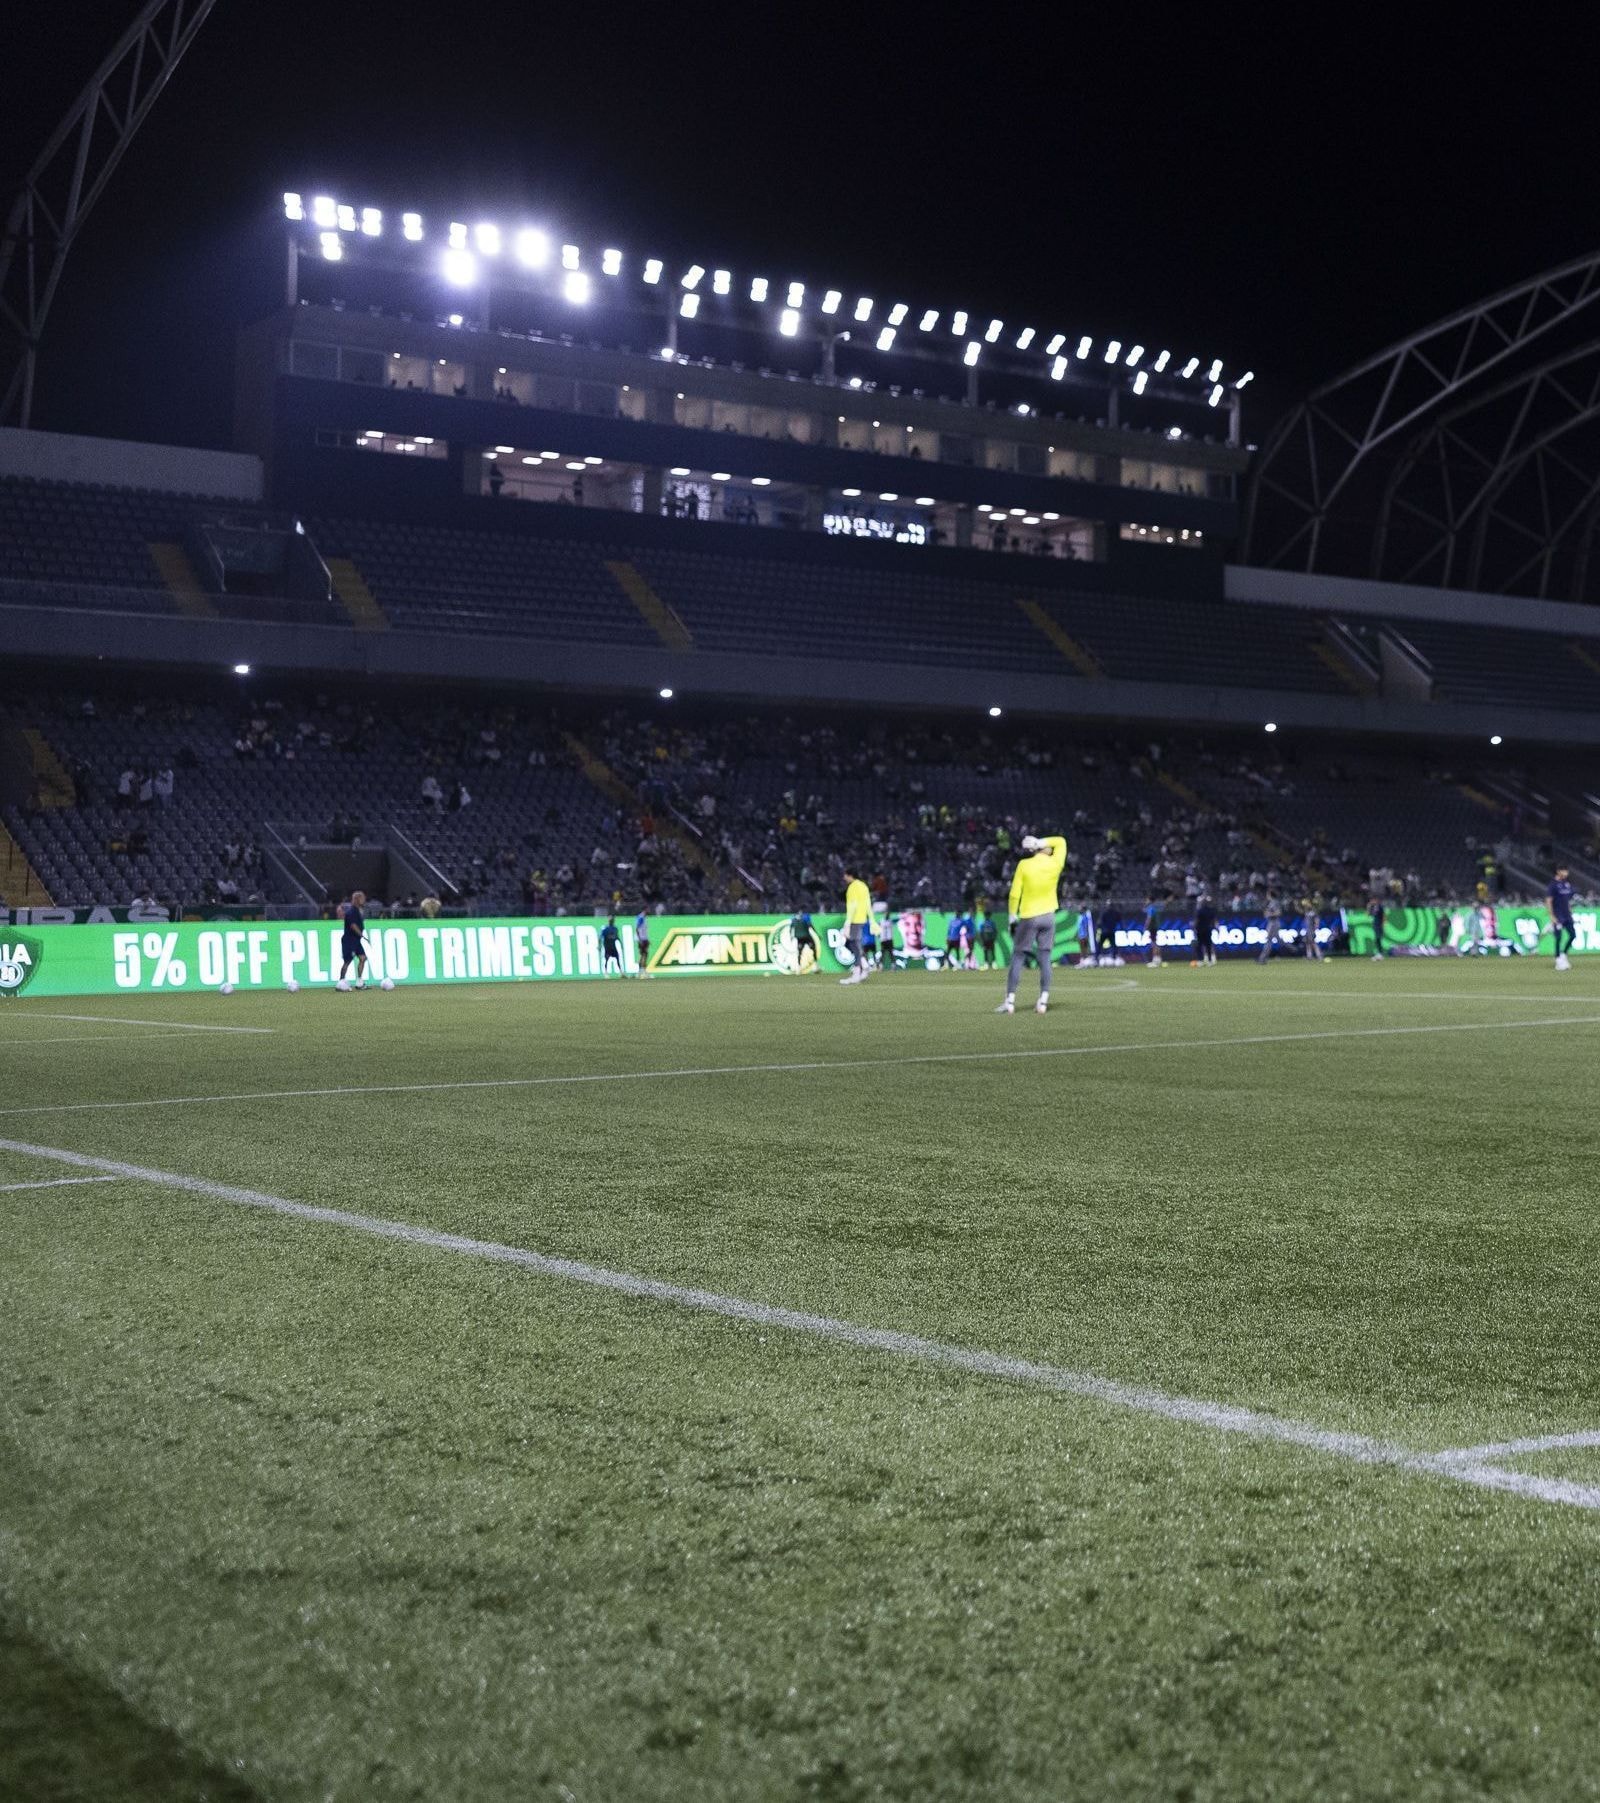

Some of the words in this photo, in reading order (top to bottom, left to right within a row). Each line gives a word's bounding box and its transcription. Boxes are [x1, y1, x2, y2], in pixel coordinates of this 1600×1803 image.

[0, 944, 32, 965] IA
[113, 932, 187, 988] 5%
[198, 931, 268, 986] OFF
[662, 934, 768, 964] AVANTI
